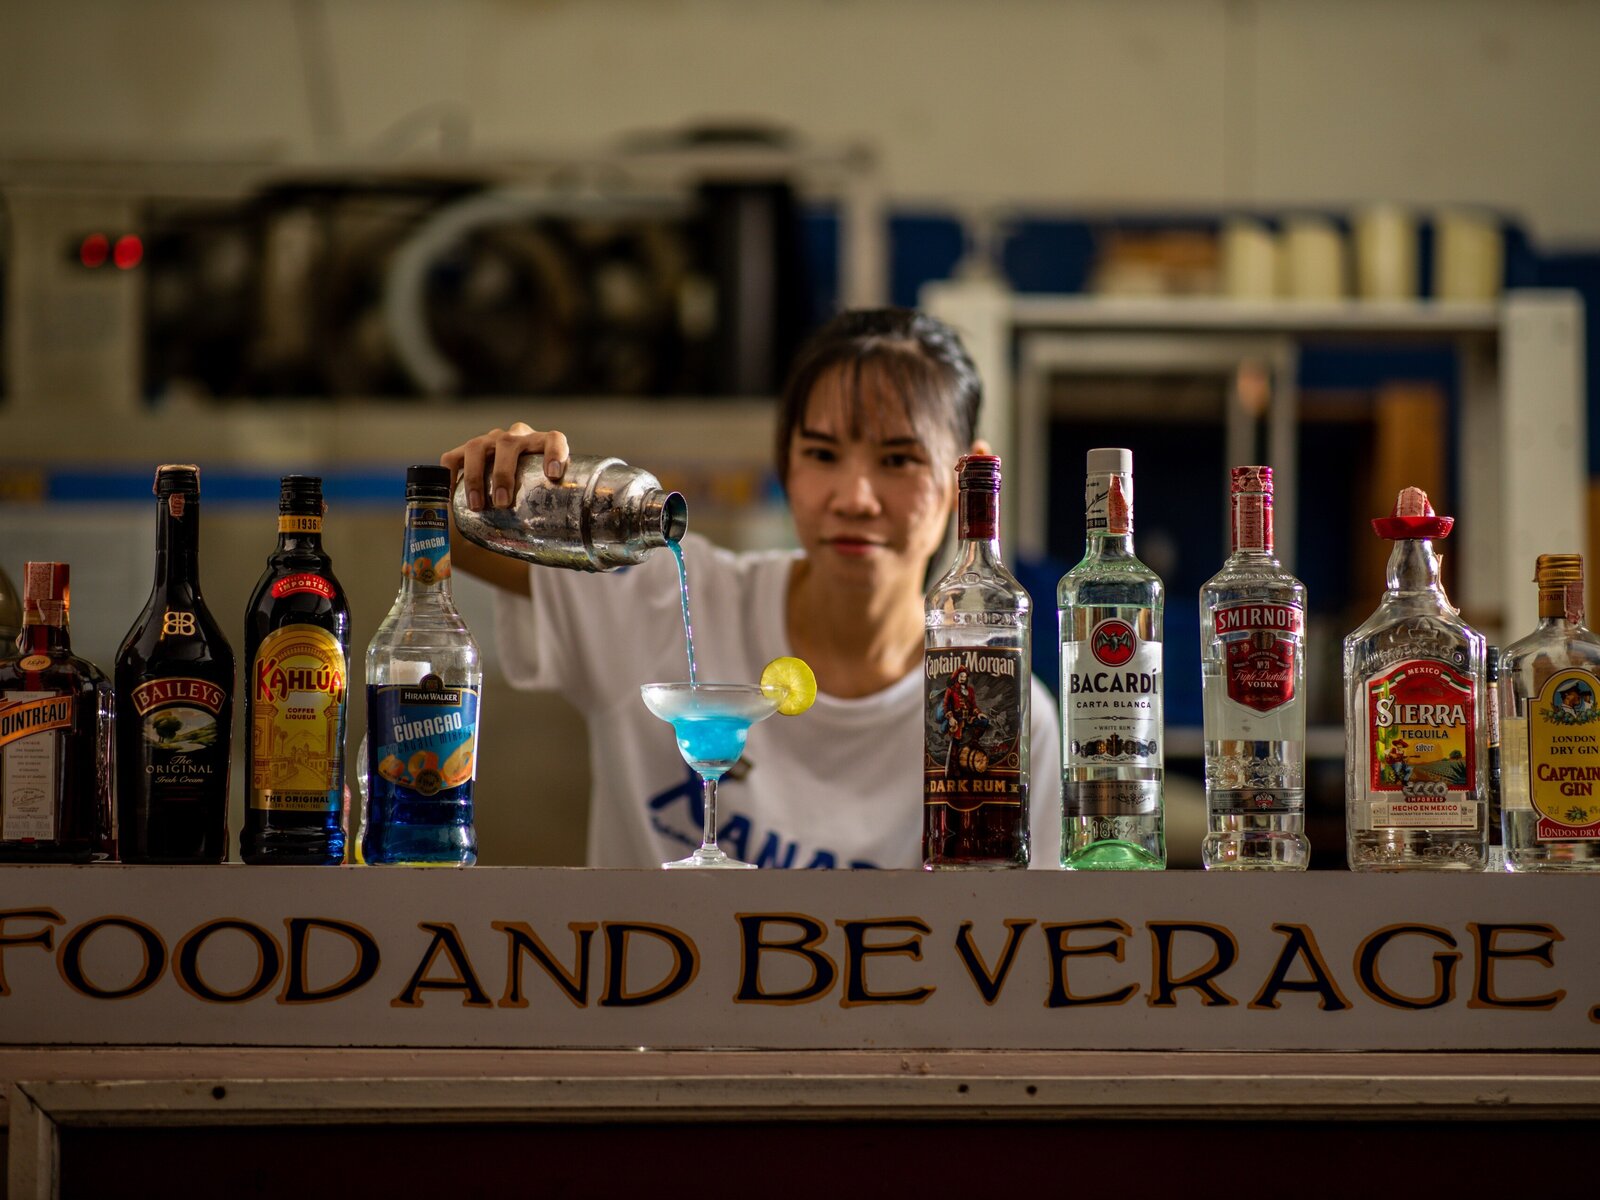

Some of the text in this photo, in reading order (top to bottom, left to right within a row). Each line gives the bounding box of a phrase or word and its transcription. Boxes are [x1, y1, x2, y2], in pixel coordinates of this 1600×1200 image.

[297, 518, 317, 530] 1936
[279, 580, 329, 593] IMPORTED
[925, 651, 1015, 679] Captain Morgan
[1407, 667, 1440, 675] MEXICO
[256, 657, 342, 704] KAHLÚA
[1070, 668, 1157, 694] BACARDÍ
[137, 682, 221, 707] BAILEYS
[404, 691, 458, 702] HIRAM WALKER
[1076, 700, 1152, 709] CARTA BLANCA
[1375, 694, 1467, 727] SIERRA
[1, 702, 67, 737] OINTREAU
[1400, 730, 1449, 739] TEQUILA
[1552, 735, 1596, 743] LONDON
[1550, 746, 1599, 755] DRY GIN
[169, 755, 193, 765] The
[145, 764, 213, 774] ORIGINAL
[1537, 763, 1600, 782] CAPTAIN
[155, 776, 205, 784] Irish Cream
[930, 779, 1006, 793] DARK RUM
[1560, 782, 1593, 797] GIN
[264, 795, 329, 804] THE ORIGINAL
[1540, 826, 1577, 837] LONDON
[1579, 829, 1596, 837] DRY
[0, 907, 380, 1005] FOOD
[390, 919, 700, 1008] AND
